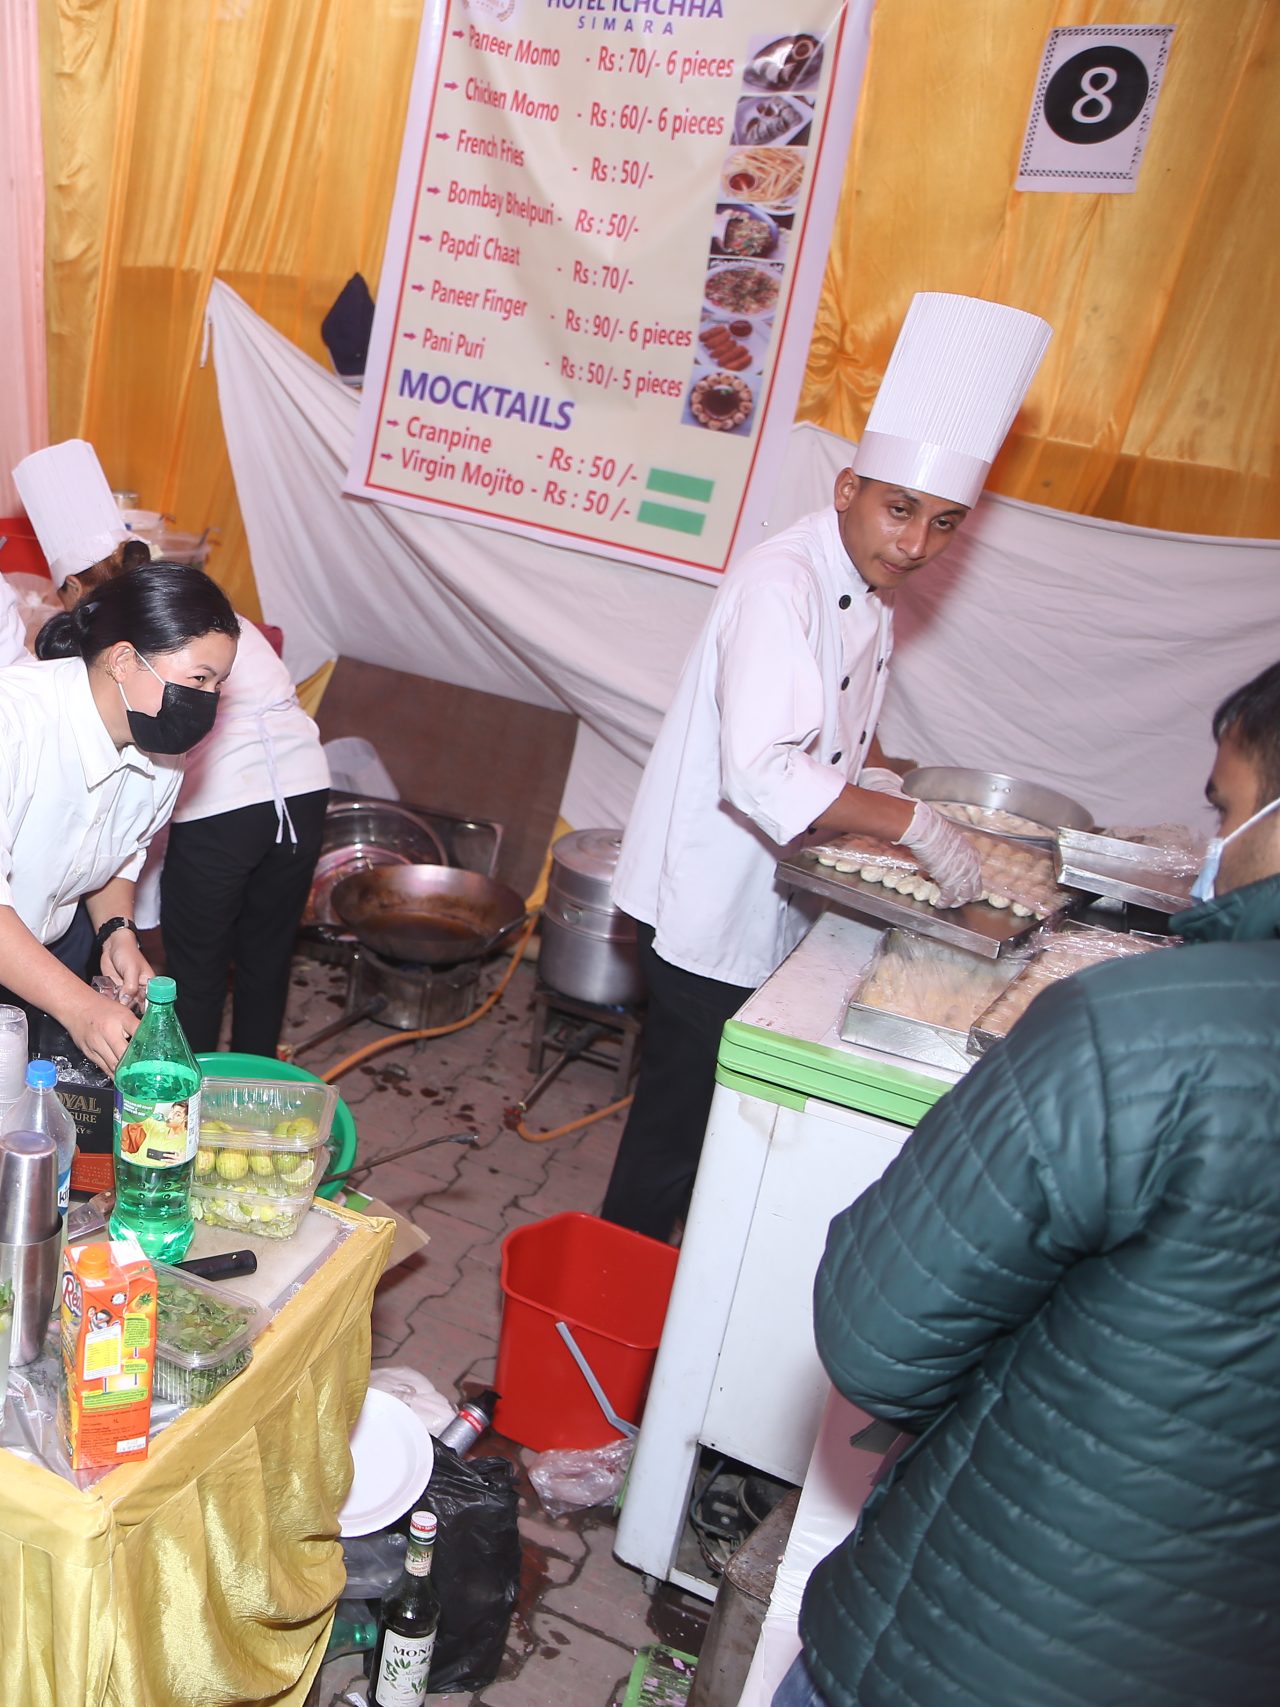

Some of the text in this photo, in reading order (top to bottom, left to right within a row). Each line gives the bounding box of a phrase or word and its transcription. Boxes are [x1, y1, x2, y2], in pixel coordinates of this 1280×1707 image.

[469, 24, 512, 57] Paneer
[515, 40, 560, 67] Momo
[628, 48, 660, 78] 70/-
[666, 50, 676, 75] 6
[680, 50, 734, 83] pieces
[578, 15, 673, 35] SIMARA
[465, 78, 506, 110] Chicken
[510, 89, 559, 122] Momo
[620, 104, 652, 134] 60/-
[658, 108, 668, 132] 6
[671, 108, 724, 139] pieces
[1072, 66, 1117, 123] 8
[456, 129, 498, 157] French
[499, 139, 524, 167] Fries
[621, 160, 653, 189] 50/-
[448, 181, 502, 217] Bombay
[506, 192, 554, 226] Bhelpuri
[606, 213, 639, 242] 50/-
[439, 231, 481, 261] Papdi
[483, 238, 521, 266] Chaat
[602, 266, 633, 294] 70/-
[431, 280, 479, 308] Paneer
[482, 288, 528, 320] Finger
[593, 315, 624, 342] 90/-
[629, 320, 638, 342] 6
[642, 322, 692, 349] pieces
[423, 328, 453, 353] Pani
[456, 334, 486, 359] Puri
[587, 362, 618, 390] 50/-
[623, 370, 630, 390] 5
[635, 370, 683, 398] pieces
[399, 369, 574, 431] MOCKTAILS
[406, 416, 492, 454] Cranpine
[401, 448, 456, 481] Virgin
[461, 462, 524, 496] Mojito
